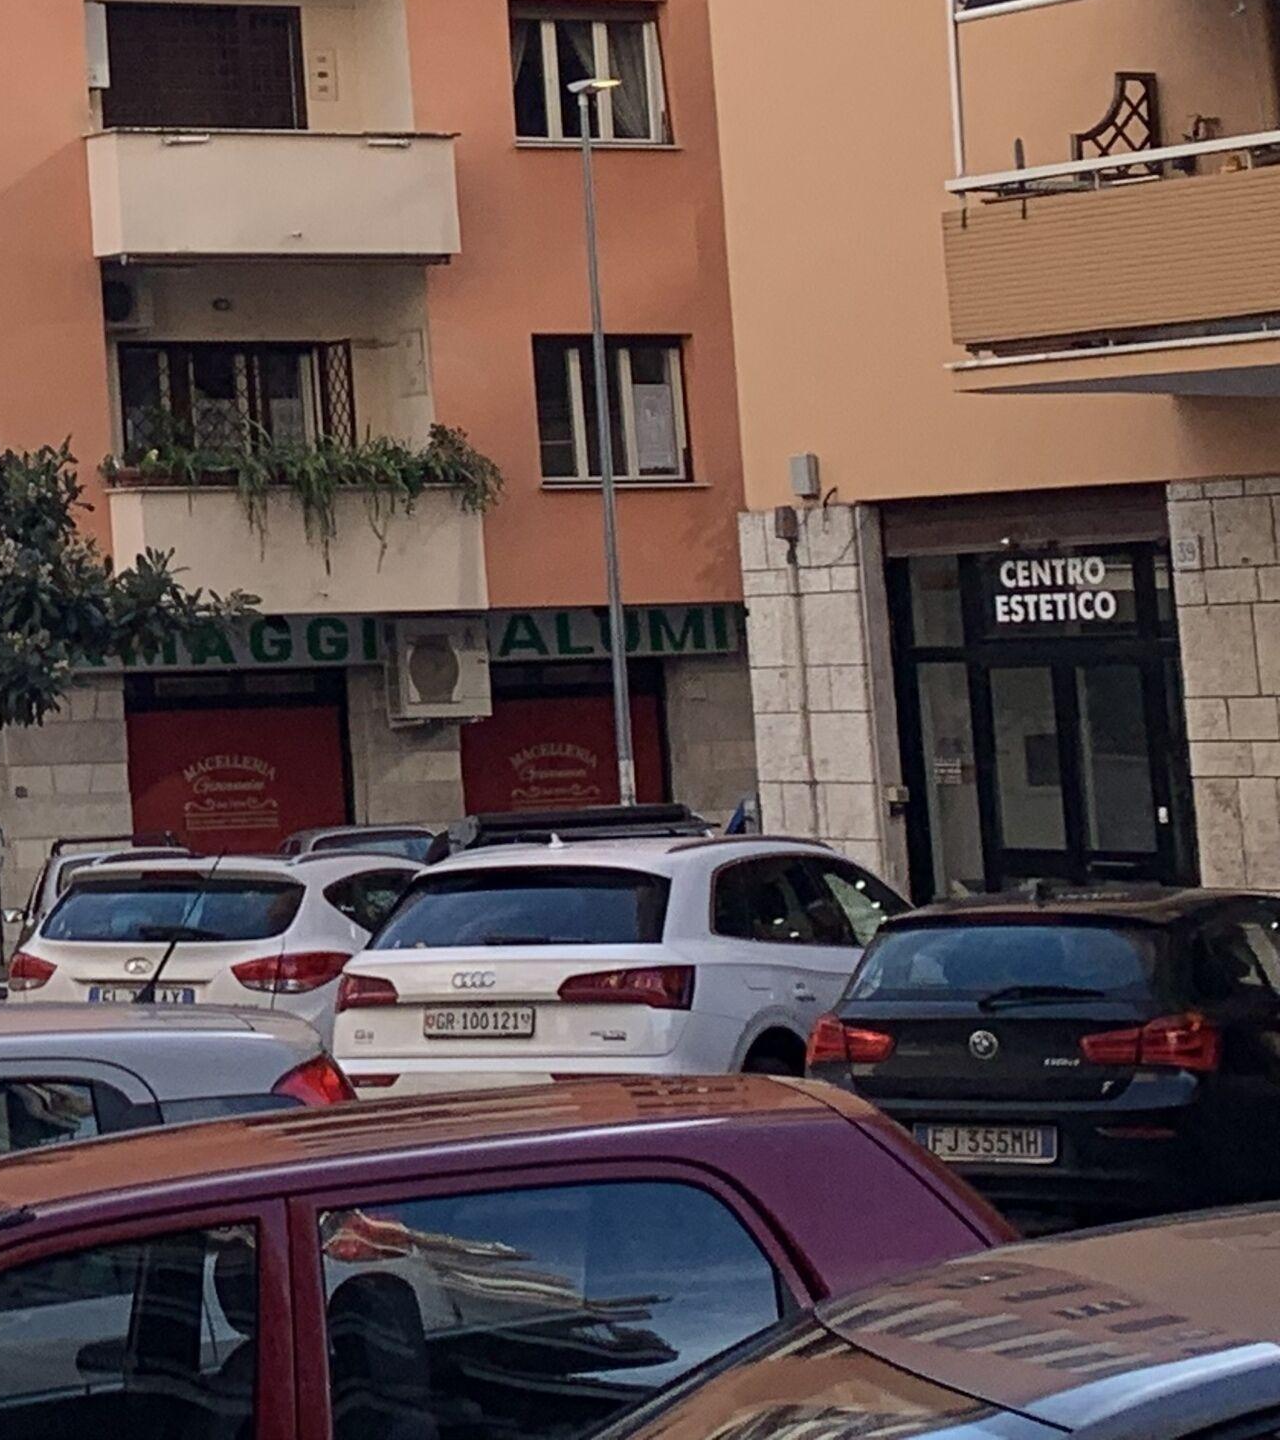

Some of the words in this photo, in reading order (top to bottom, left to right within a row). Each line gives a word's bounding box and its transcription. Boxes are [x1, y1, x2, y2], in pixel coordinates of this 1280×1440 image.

[999, 556, 1106, 588] CENTRO
[994, 591, 1117, 623] ESTETICO
[499, 605, 730, 657] ALUMI
[183, 754, 276, 782] MACELLERIA
[508, 742, 597, 769] MACELLERIA
[932, 1126, 960, 1153] FJ
[967, 1126, 1040, 1155] 355MH
